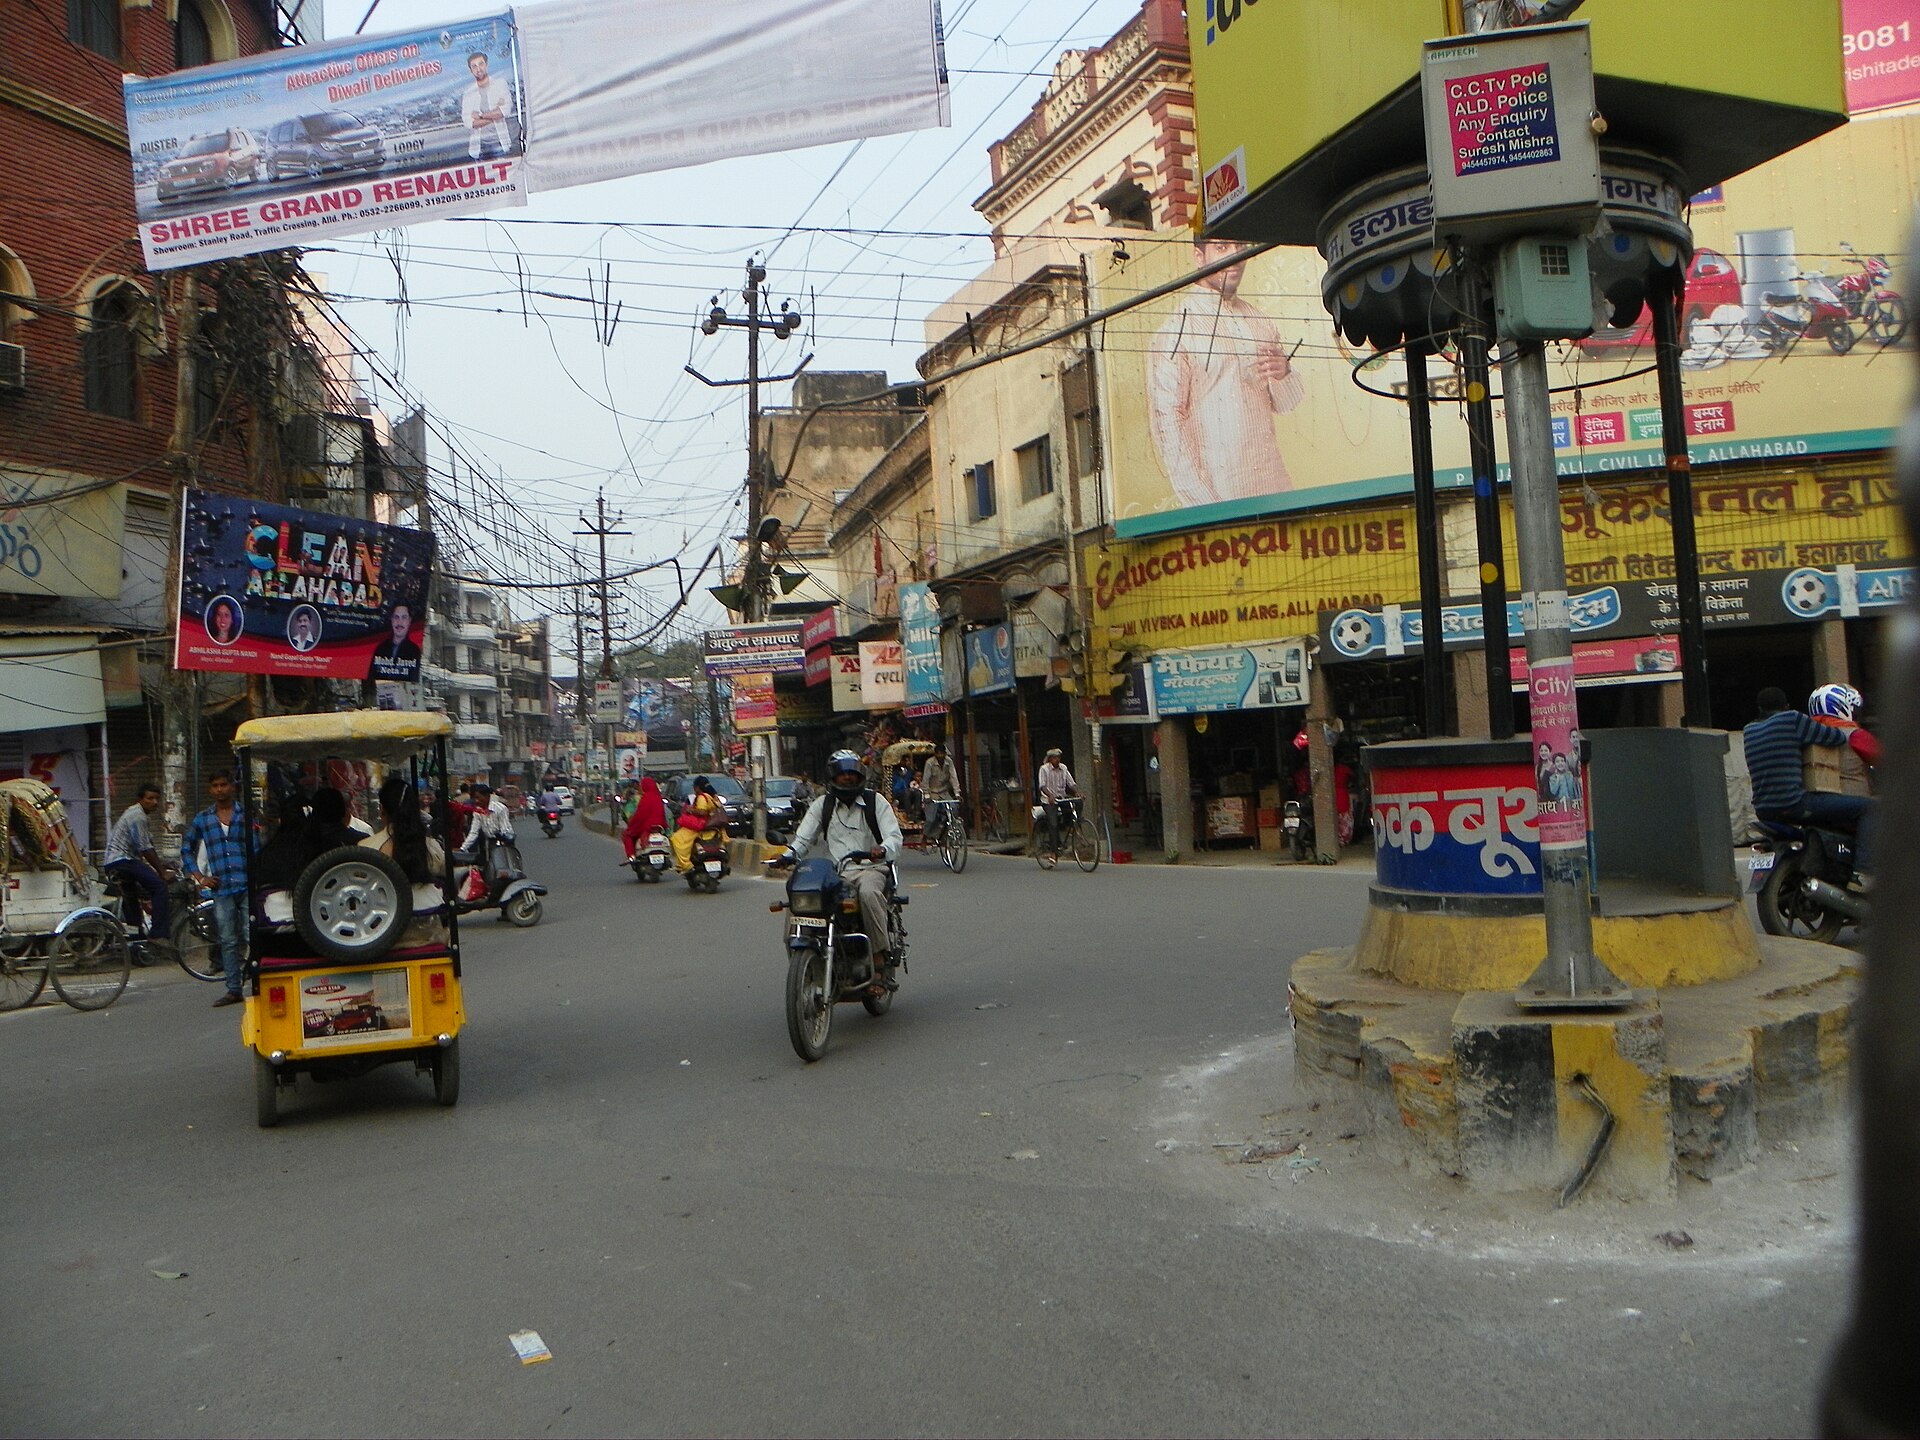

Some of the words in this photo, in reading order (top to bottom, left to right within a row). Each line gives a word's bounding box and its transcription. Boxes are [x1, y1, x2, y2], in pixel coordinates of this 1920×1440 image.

[286, 60, 353, 91] Attractive
[355, 49, 398, 73] Offers
[402, 43, 421, 59] on
[328, 78, 371, 103] Diwali
[373, 59, 442, 91] Deliveries
[1510, 71, 1548, 89] Pole
[1455, 98, 1493, 116] ALD.
[1497, 91, 1548, 109] Police
[1458, 118, 1486, 132] Any
[1490, 107, 1548, 126] Enquiry
[1476, 125, 1530, 143] Contact
[140, 136, 178, 154] DUSTER
[393, 138, 426, 153] LODGY
[1459, 142, 1505, 159] Suresh
[1509, 135, 1554, 151] Mishra
[1508, 149, 1553, 163] 9454402863
[150, 208, 251, 243] SHREE
[259, 188, 363, 223] GRAND
[373, 162, 513, 204] RENAULT
[153, 242, 198, 256] Showroom:
[198, 235, 228, 248] Stanley
[229, 231, 253, 242] Road,
[254, 225, 281, 238] Traffic
[282, 217, 320, 232] Crossing,
[321, 214, 340, 225] Alld.
[359, 200, 424, 218] 0532-2266099,
[425, 194, 462, 207] 3192095
[464, 183, 516, 200] 9235442095
[1628, 392, 1648, 405] और
[1698, 385, 1724, 399] इनाम
[1584, 417, 1614, 431] दैनिक
[1640, 424, 1662, 439] इना
[1693, 418, 1726, 433] इनाम
[1584, 429, 1616, 444] इनाम
[1599, 455, 1643, 471] CIVIL
[1708, 440, 1808, 462] ALLAHABAD
[245, 520, 385, 587] CLEAN
[1095, 522, 1292, 610] Educational
[1300, 518, 1407, 561] HOUSE
[245, 568, 384, 610] ALLAHABAD
[1709, 578, 1749, 592] सामान
[1657, 600, 1672, 614] के
[1140, 614, 1186, 633] VIVEKA
[1190, 608, 1229, 627] NAND
[752, 633, 800, 646] समाचार
[1015, 645, 1044, 660] TITAN
